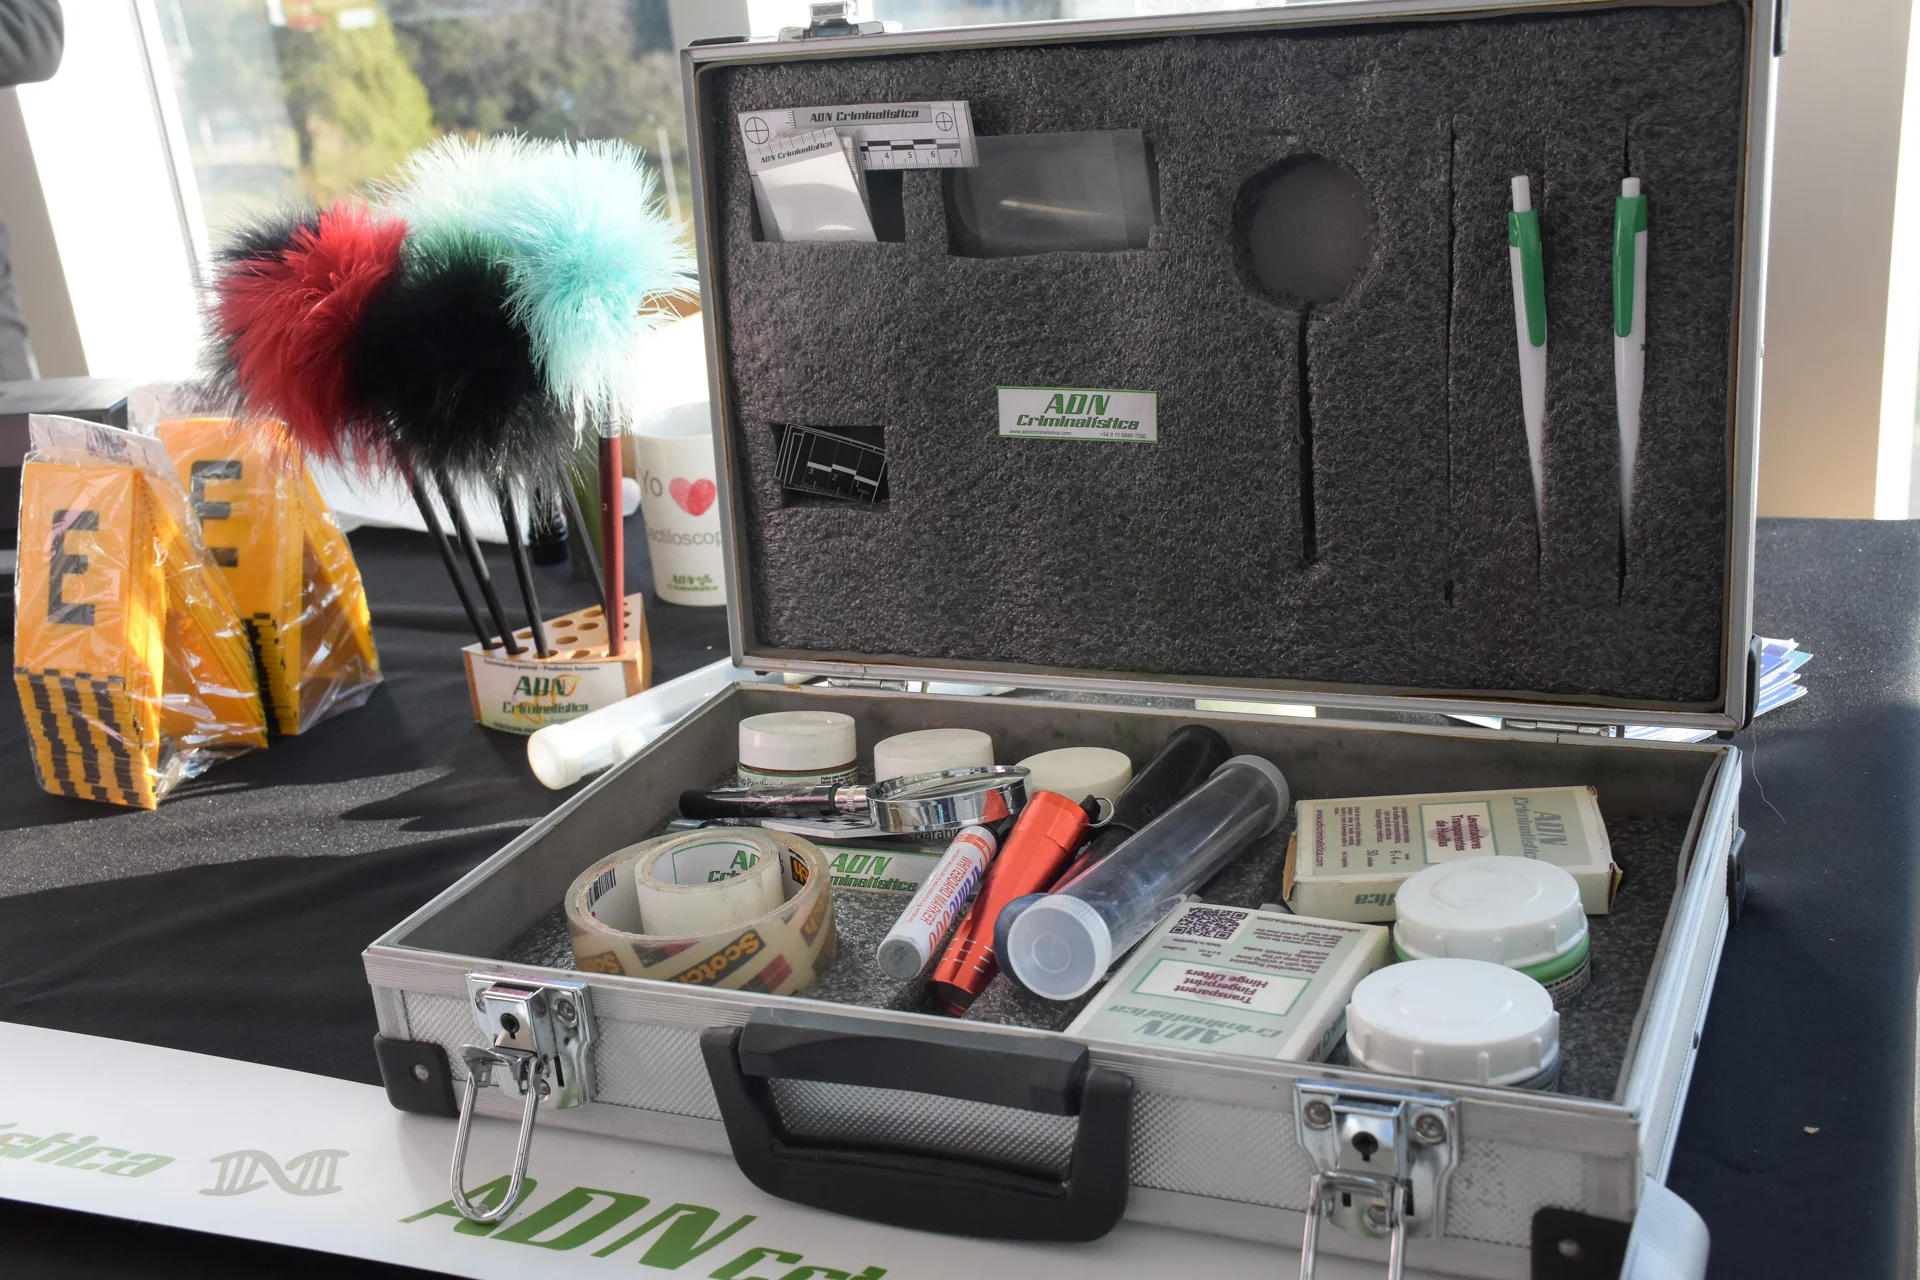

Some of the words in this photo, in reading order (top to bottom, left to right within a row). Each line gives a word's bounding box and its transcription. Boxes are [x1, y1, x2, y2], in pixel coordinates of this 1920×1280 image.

[809, 111, 833, 123] ADN
[760, 153, 776, 164] ADN
[907, 151, 913, 159] 5
[930, 150, 936, 158] 6
[953, 150, 958, 158] 7
[1043, 393, 1111, 416] ADN
[1016, 414, 1140, 430] Criminalística
[808, 467, 815, 475] 3
[831, 473, 838, 481] 2
[191, 460, 243, 568] E
[47, 509, 99, 626] E
[513, 675, 567, 697] ADN
[1436, 820, 1449, 828] de
[1451, 814, 1466, 851] Transparentes
[1467, 814, 1482, 849] Levantadores
[1512, 796, 1540, 860] Criminalístic
[1532, 810, 1568, 846] ADN
[1436, 827, 1452, 848] Huellas
[829, 853, 893, 875] ADN
[939, 855, 974, 898] WHITEBOARD
[920, 894, 948, 926] MARKER
[1183, 977, 1257, 996] Fingerprint
[1185, 969, 1227, 982] Lifters
[1228, 974, 1269, 988] Hinge
[1174, 984, 1252, 1004] Transparent
[1132, 1019, 1237, 1044] ADN
[397, 1174, 758, 1271] ADN
